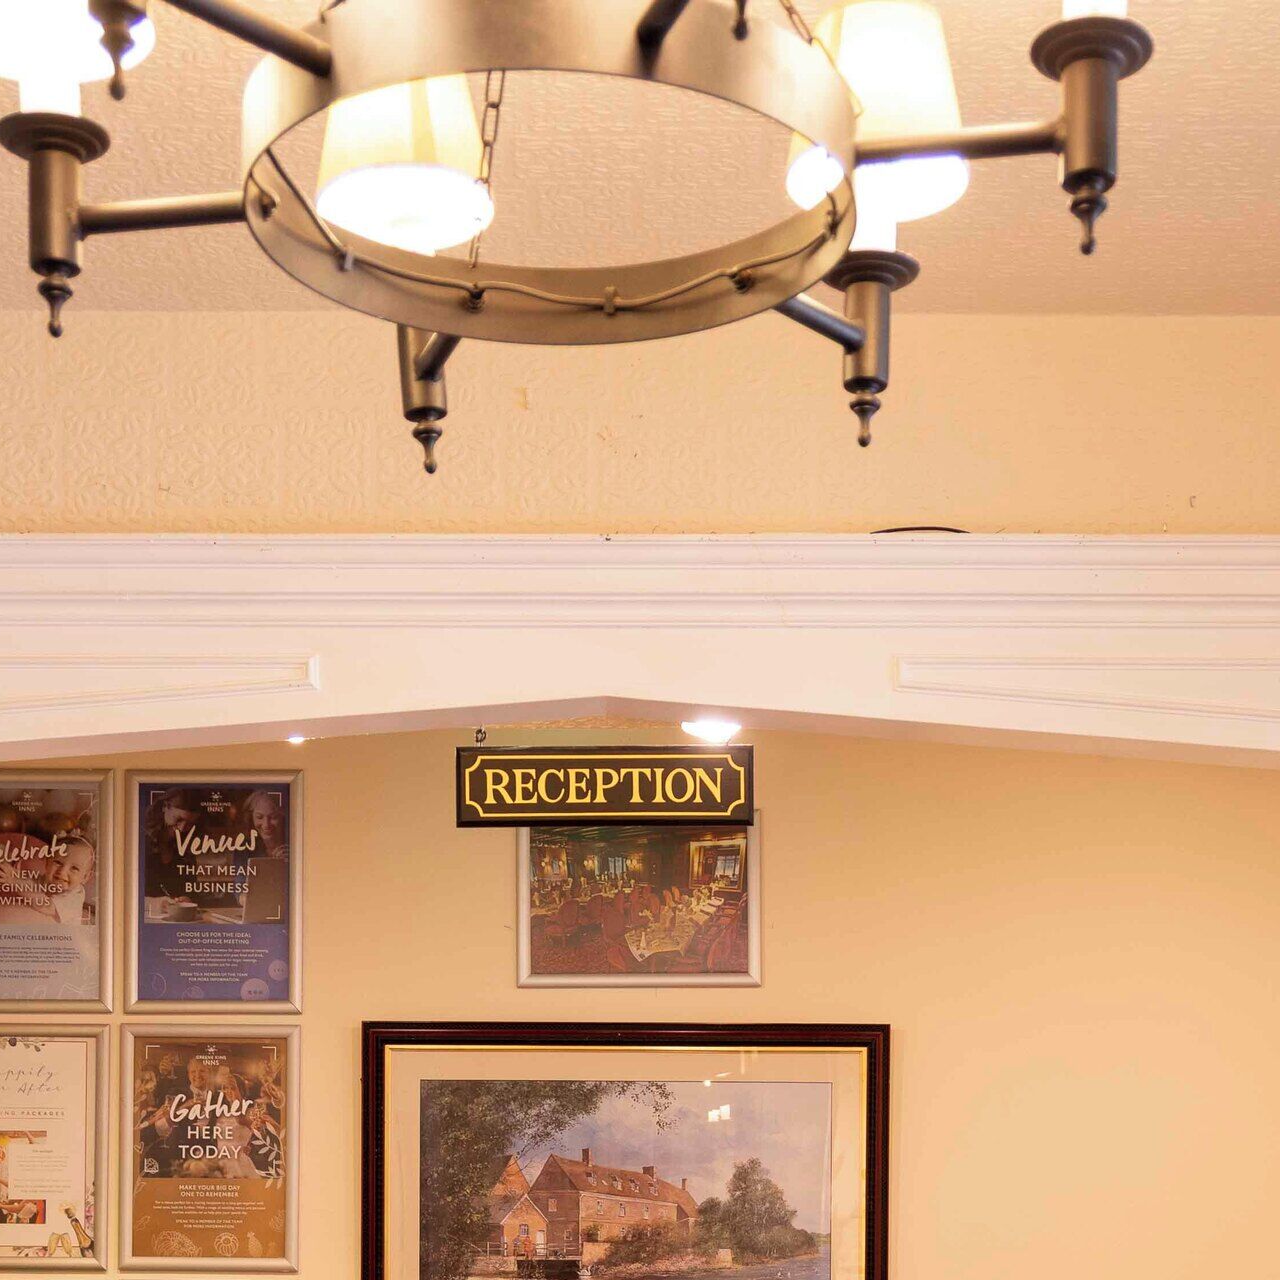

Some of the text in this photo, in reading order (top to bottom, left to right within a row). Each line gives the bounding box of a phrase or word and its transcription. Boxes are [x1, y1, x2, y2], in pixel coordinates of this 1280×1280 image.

[483, 767, 724, 805] RECEPTION
[175, 825, 258, 857] Venues
[11, 870, 40, 879] NEW
[177, 865, 257, 876] THAT MEAN
[185, 883, 249, 893] BUSINESS
[0, 896, 51, 906] WITH US
[17, 1082, 63, 1096] After
[169, 1090, 254, 1122] Gather
[187, 1126, 234, 1139] HERE
[178, 1145, 241, 1159] TODAY
